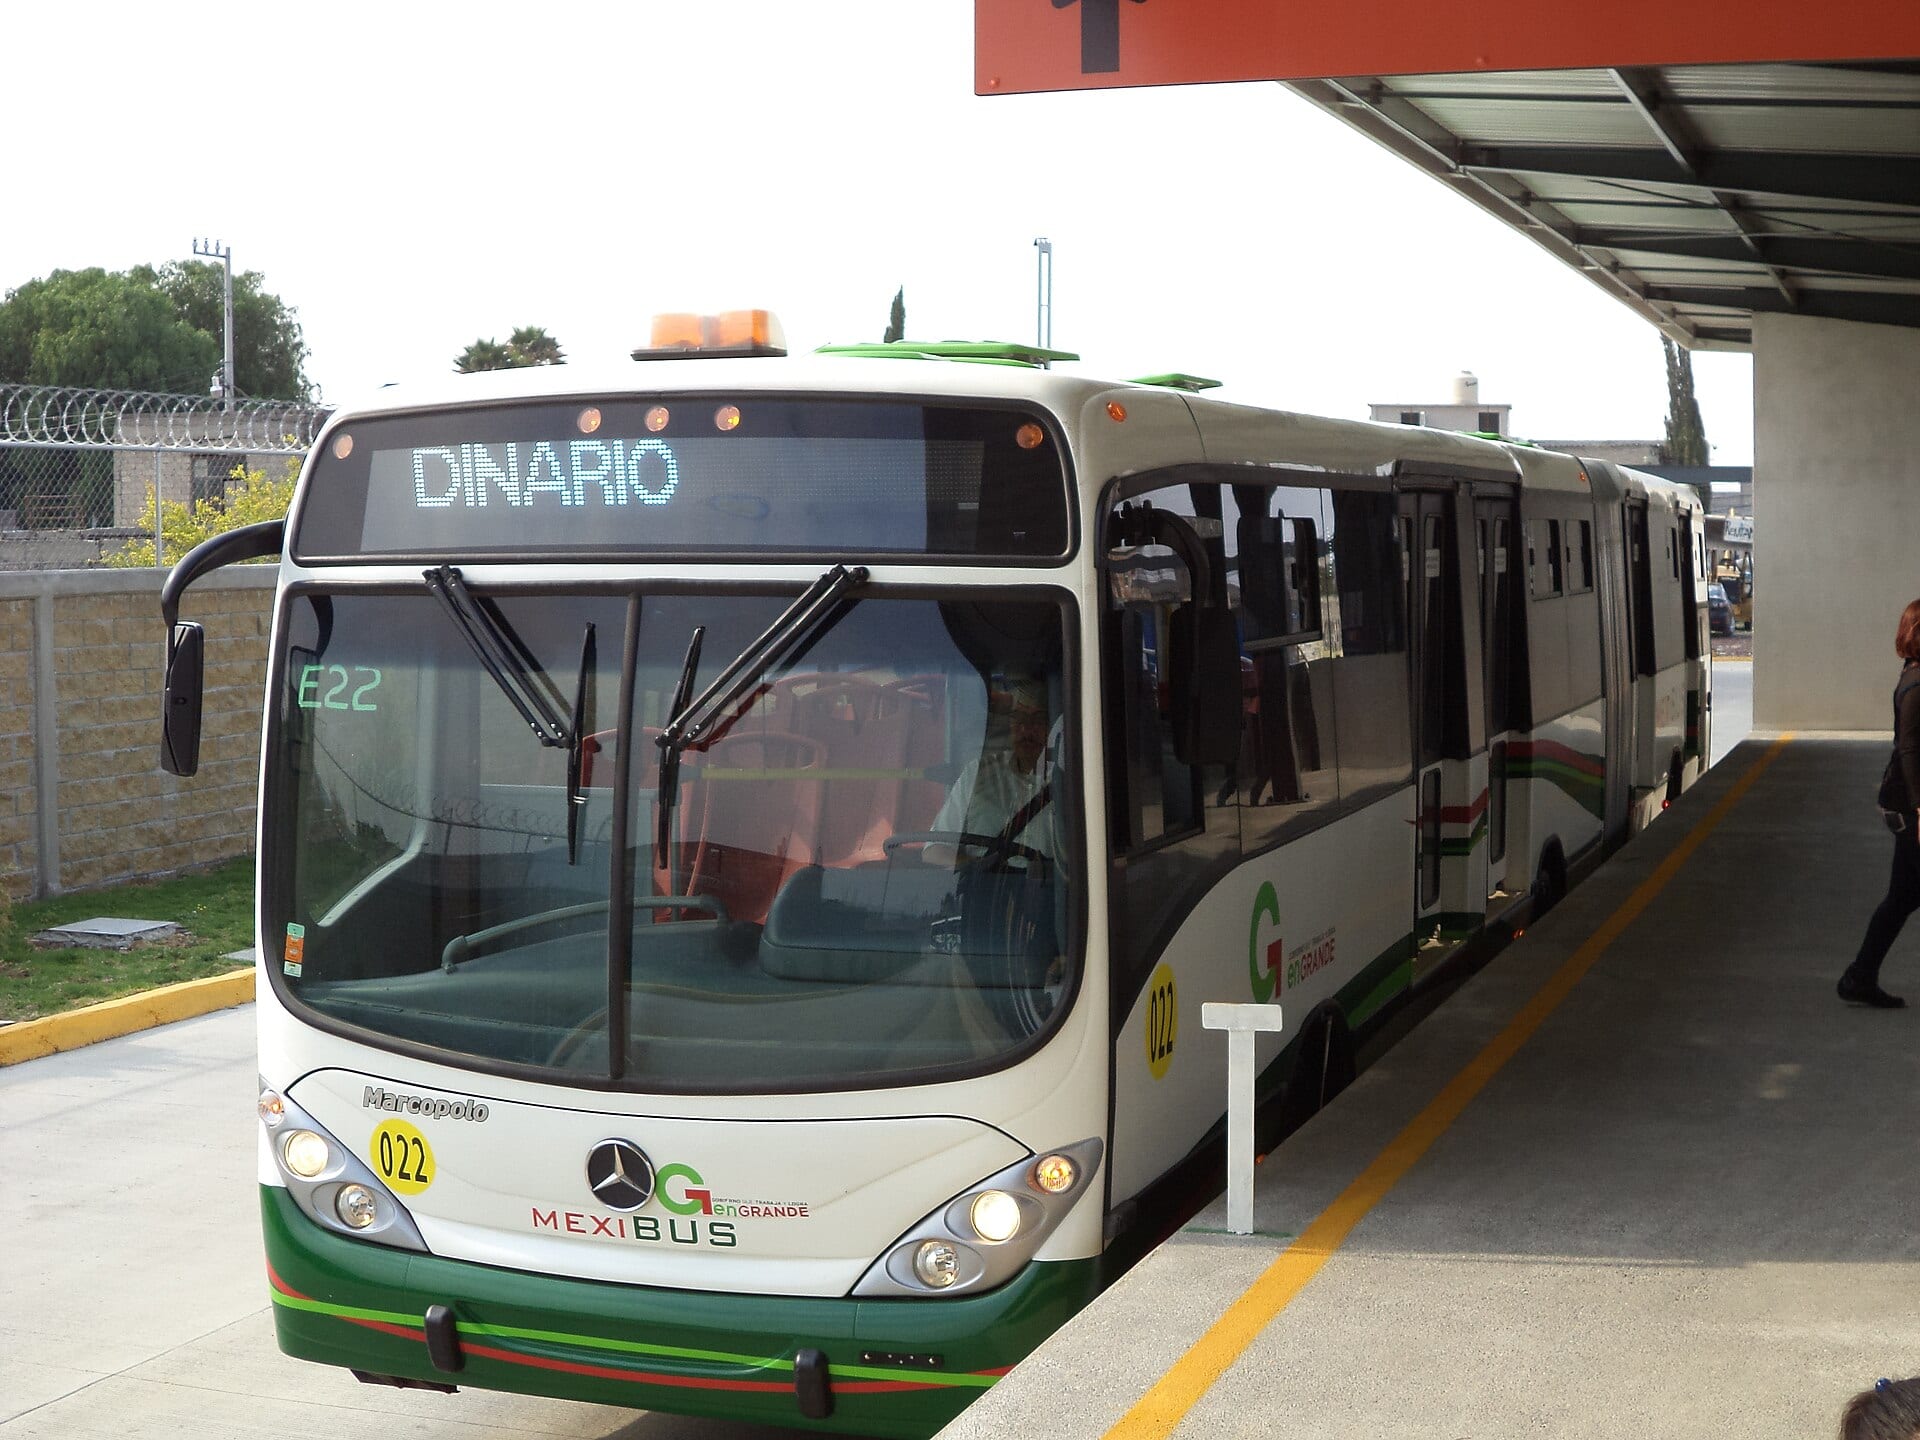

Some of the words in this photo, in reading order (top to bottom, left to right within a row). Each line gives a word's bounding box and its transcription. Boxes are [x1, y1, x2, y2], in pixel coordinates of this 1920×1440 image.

[412, 439, 679, 507] DINARIO
[298, 664, 382, 711] E22
[1150, 981, 1175, 1064] 022
[363, 1085, 490, 1122] Marcopolo
[380, 1130, 428, 1184] 022
[531, 1207, 737, 1247] MEXIBUS
